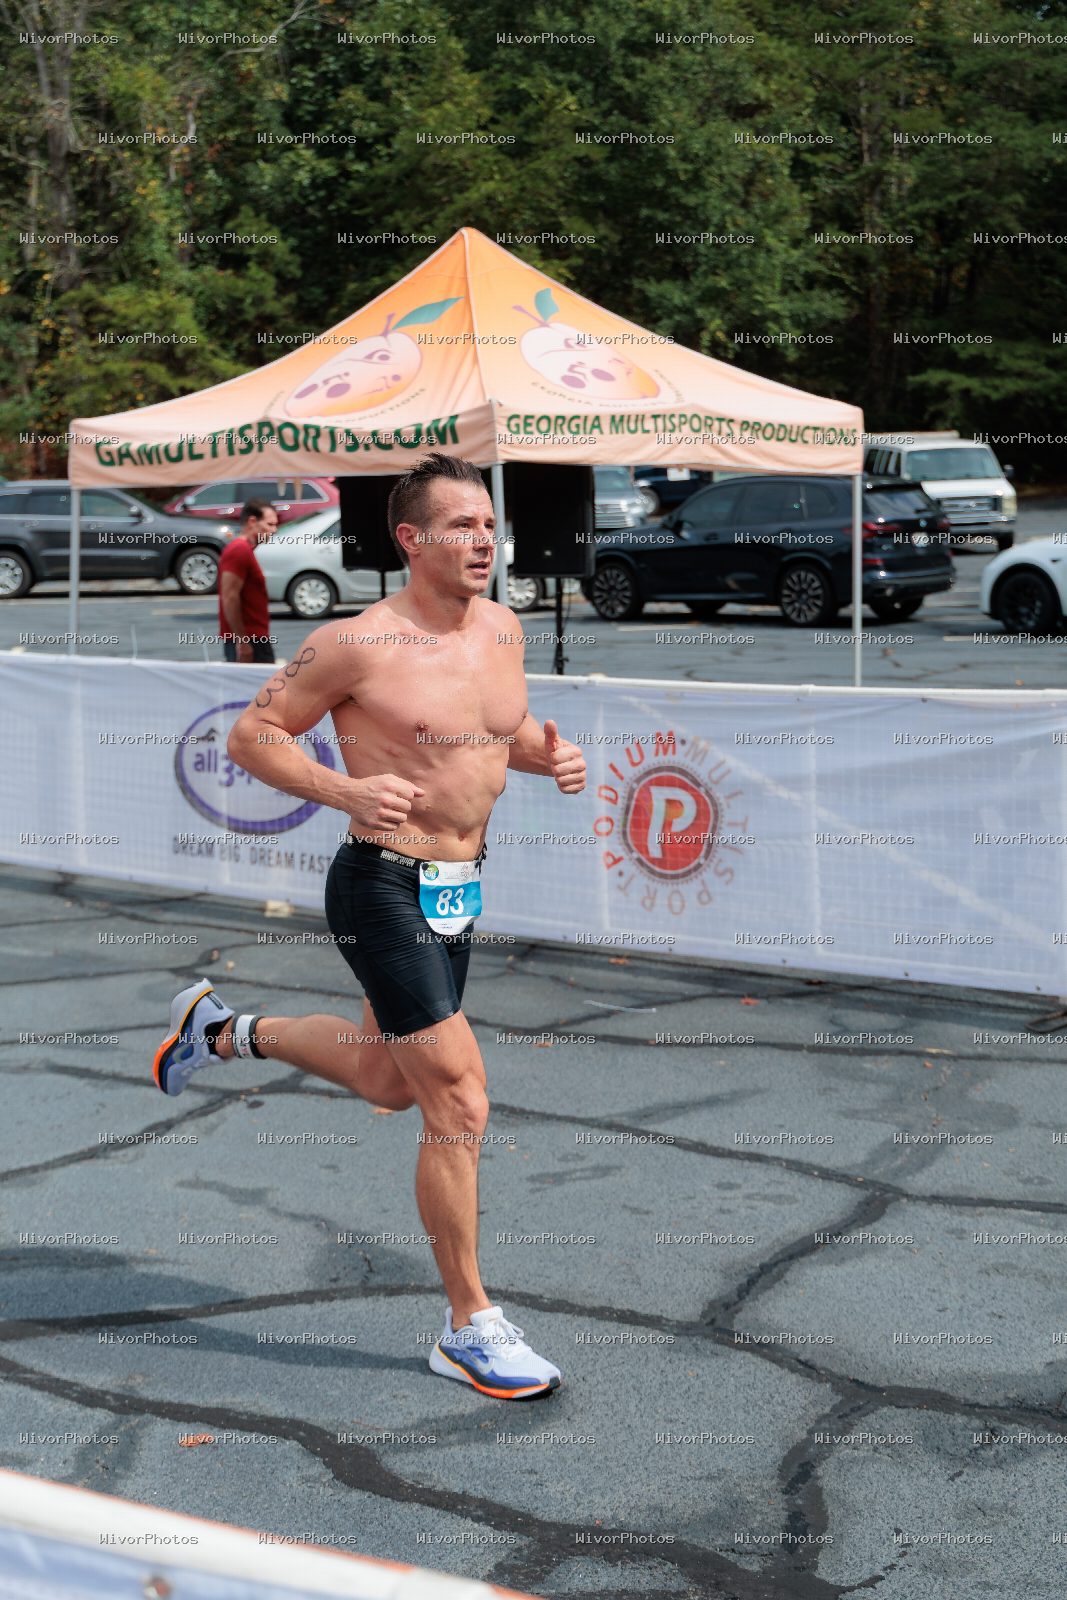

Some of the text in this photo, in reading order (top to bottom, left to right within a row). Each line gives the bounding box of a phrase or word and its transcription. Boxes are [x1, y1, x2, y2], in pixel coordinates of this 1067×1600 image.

[94, 414, 460, 467] GAMULTISPORTS.COM
[506, 412, 858, 446] GEORGIA MULTISPORTS PRODUCTIONS
[593, 730, 677, 871] PODIUM
[250, 846, 295, 869] DREAM
[435, 887, 465, 916] 83
